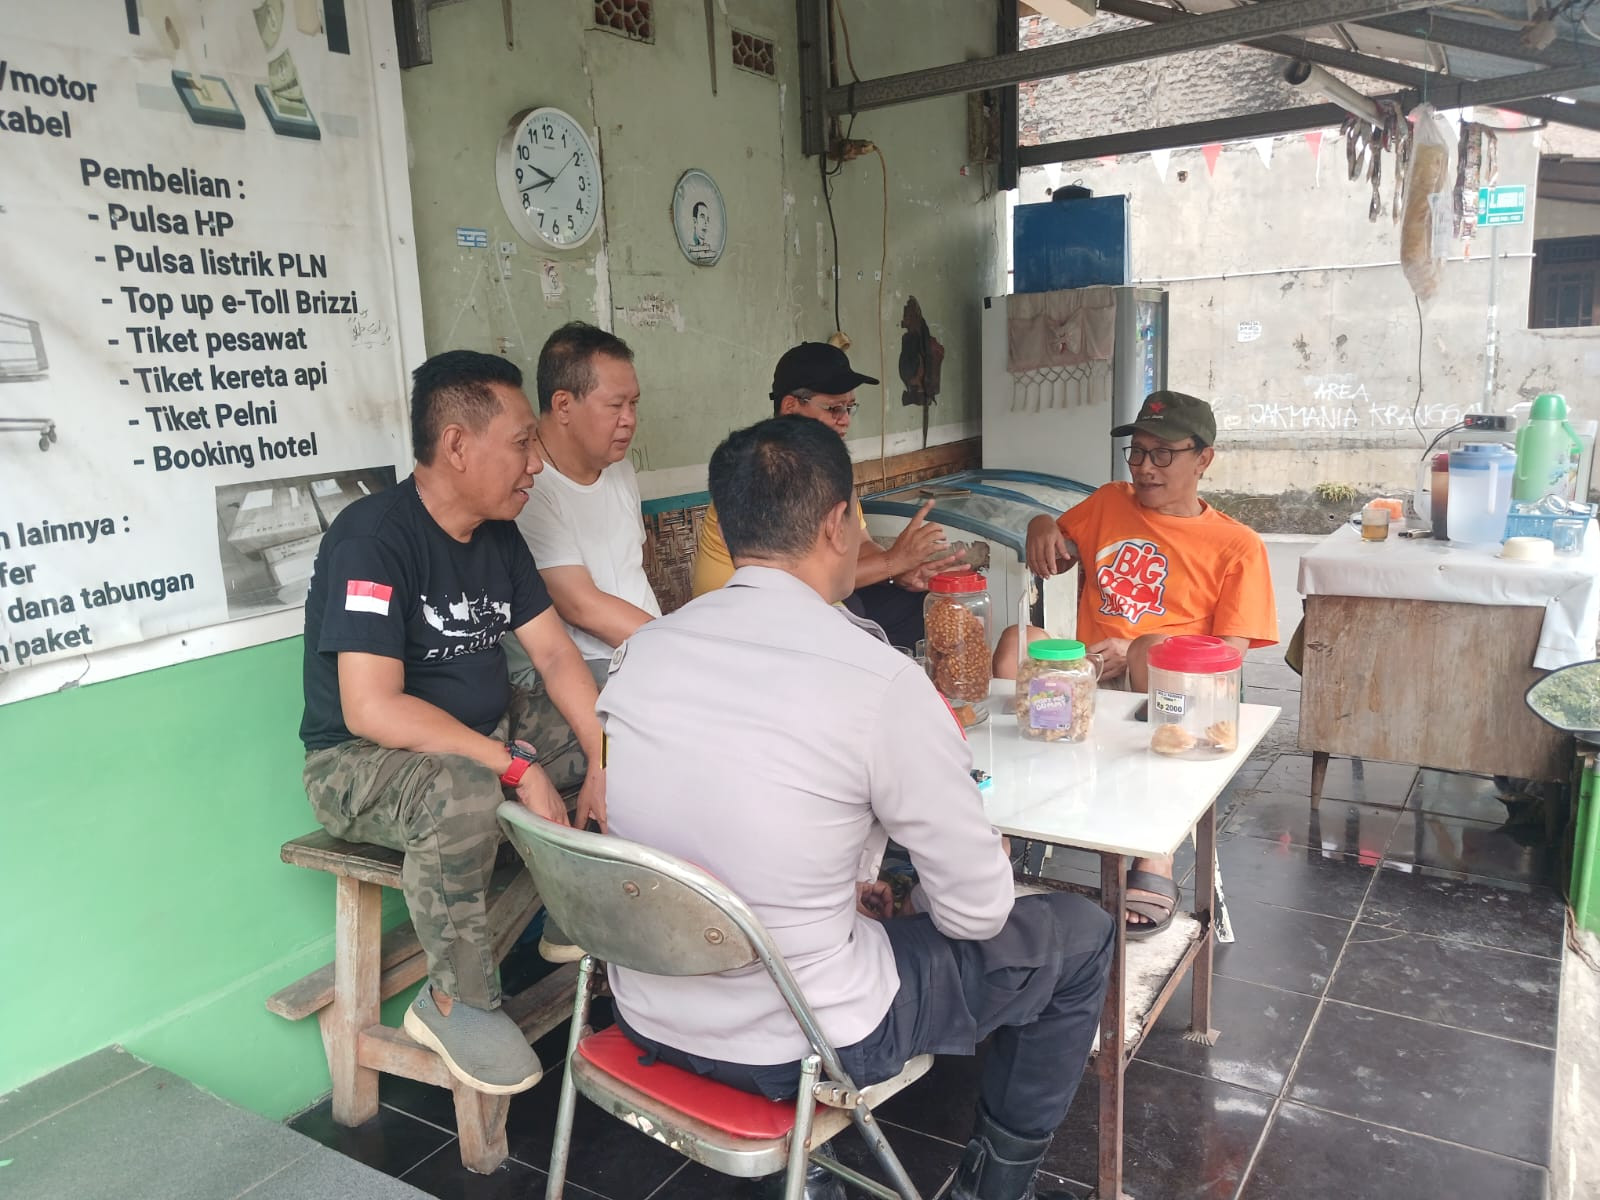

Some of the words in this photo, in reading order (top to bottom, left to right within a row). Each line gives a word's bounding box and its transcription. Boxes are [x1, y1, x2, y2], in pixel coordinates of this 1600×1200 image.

[528, 128, 538, 144] 11
[542, 123, 554, 140] 12
[561, 133, 567, 148] 1
[516, 144, 529, 161] 10
[573, 151, 581, 167] 2
[80, 158, 231, 199] Pembelian
[515, 167, 523, 184] 9
[578, 175, 585, 191] 3
[522, 192, 530, 210] 8
[576, 198, 584, 214] 4
[108, 203, 189, 235] Pulsa
[194, 209, 234, 237] HP
[537, 212, 544, 228] 7
[552, 219, 560, 235] 6
[567, 214, 575, 230] 5
[114, 244, 195, 275] Pulsa
[200, 248, 274, 276] listrik
[278, 252, 327, 278] PLN
[120, 286, 174, 320] Top
[181, 292, 214, 320] up
[221, 288, 290, 314] e-Toll
[295, 290, 358, 314] Brizzi
[126, 326, 199, 353] Tiket
[206, 328, 307, 358] pesawat
[133, 366, 204, 393] Tiket
[210, 364, 289, 390] kereta
[294, 361, 328, 391] api
[1314, 382, 1369, 402] AREA
[145, 405, 211, 432] Tiket
[215, 400, 278, 428] Pelni
[1248, 402, 1361, 429] JAKMANIA
[153, 441, 255, 471] Booking
[257, 432, 318, 461] hotel
[17, 517, 116, 547] lainnya
[7, 597, 76, 624] dana
[79, 572, 195, 609] tabungan
[14, 624, 93, 665] paket
[1165, 703, 1183, 713] 2000
